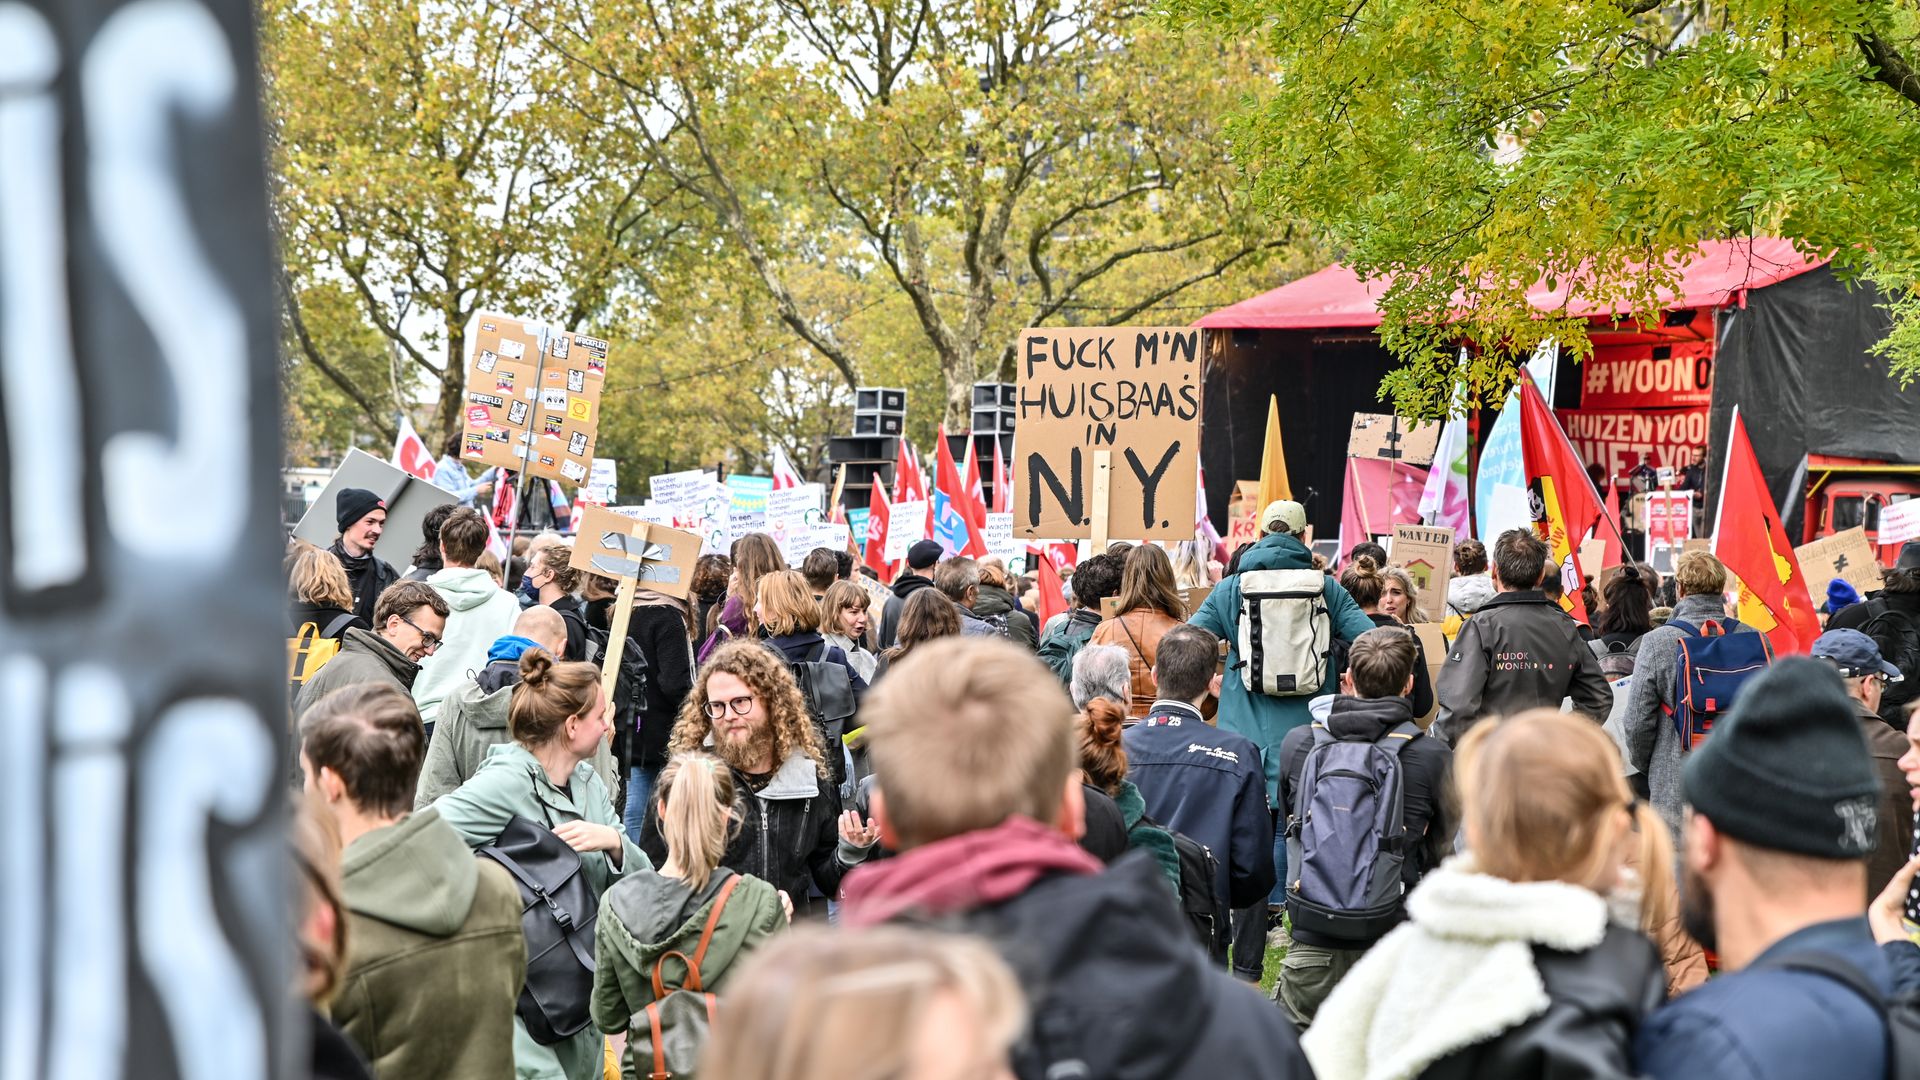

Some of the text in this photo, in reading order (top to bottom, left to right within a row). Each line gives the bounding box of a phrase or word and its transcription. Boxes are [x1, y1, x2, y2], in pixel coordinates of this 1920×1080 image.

[1027, 336, 1115, 379] FUCK
[470, 392, 502, 405] #FUCKFLEX
[1020, 377, 1199, 421] HUISBAAS
[1087, 423, 1116, 446] IN
[1568, 413, 1709, 444] HUIZEN VOO
[731, 520, 765, 530] wachtlijst
[1003, 531, 1011, 539] je
[1398, 529, 1450, 545] WANTED
[1496, 662, 1531, 670] WONEN
